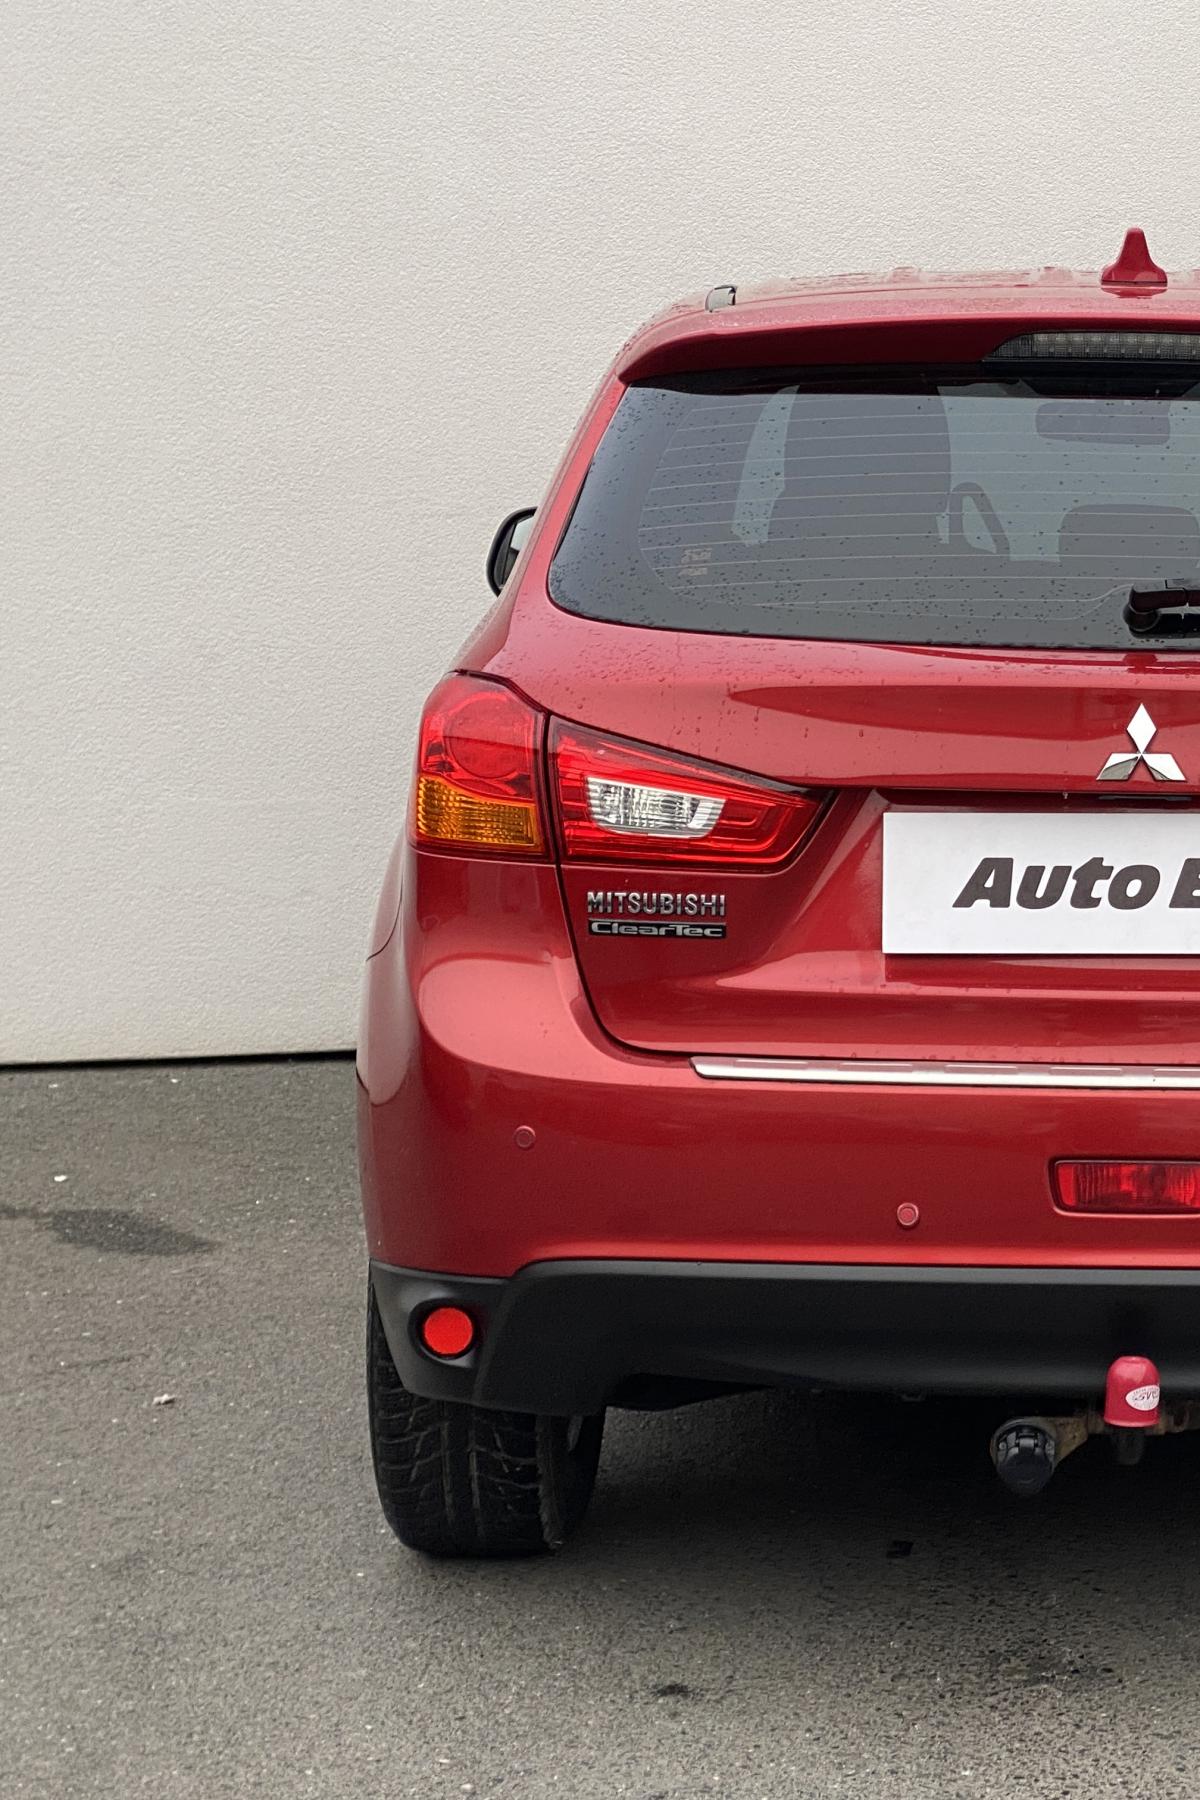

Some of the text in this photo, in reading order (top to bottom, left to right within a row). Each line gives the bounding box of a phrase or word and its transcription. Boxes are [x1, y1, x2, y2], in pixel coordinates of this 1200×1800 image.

[952, 857, 1161, 910] Auto
[587, 891, 726, 916] MITSUBISHI
[591, 921, 723, 937] ClearTec
